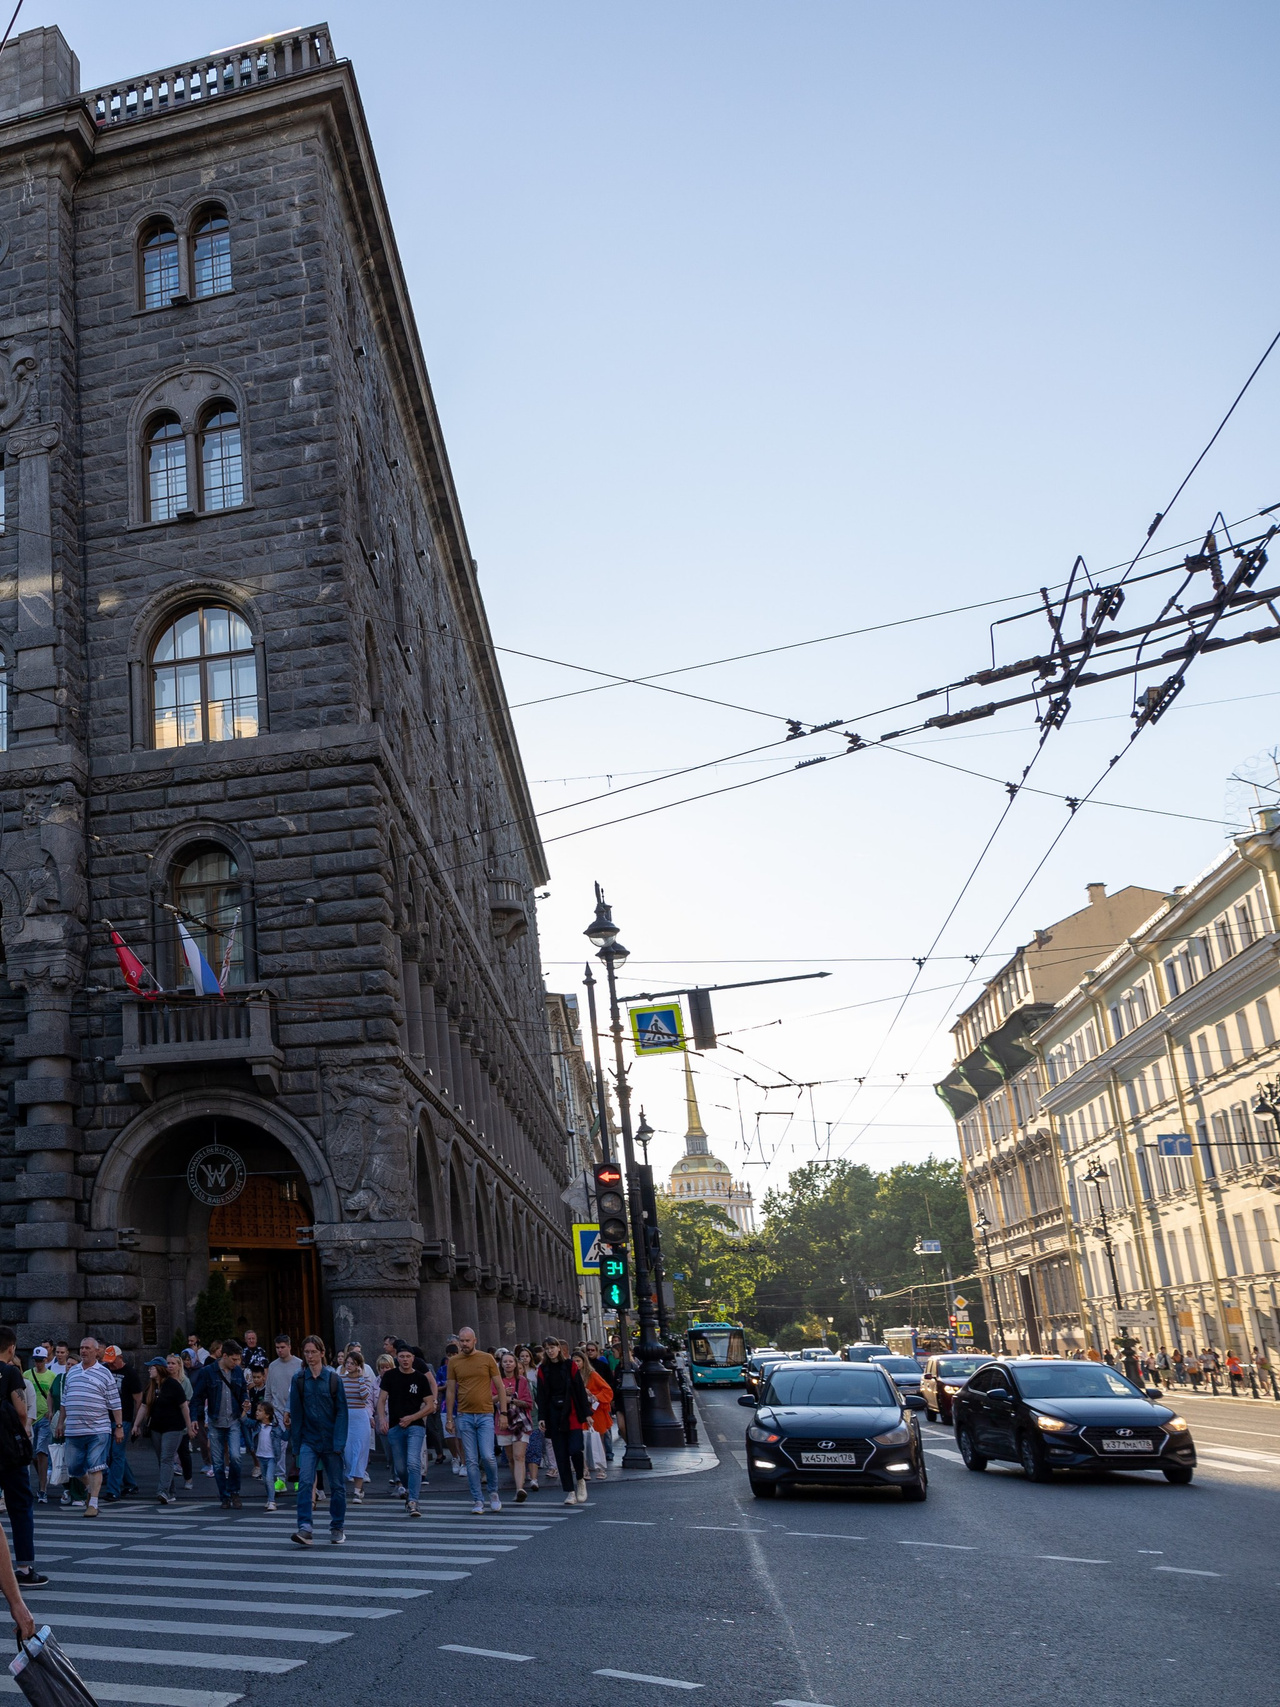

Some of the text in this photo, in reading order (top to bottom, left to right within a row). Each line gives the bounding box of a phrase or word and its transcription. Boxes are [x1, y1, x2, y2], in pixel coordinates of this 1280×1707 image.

[189, 1146, 243, 1173] WAWELBERG HOTEL
[190, 1178, 243, 1204] ОТЕЛЬ ВАВЕЛЬБЕРГ
[606, 1261, 623, 1275] 34
